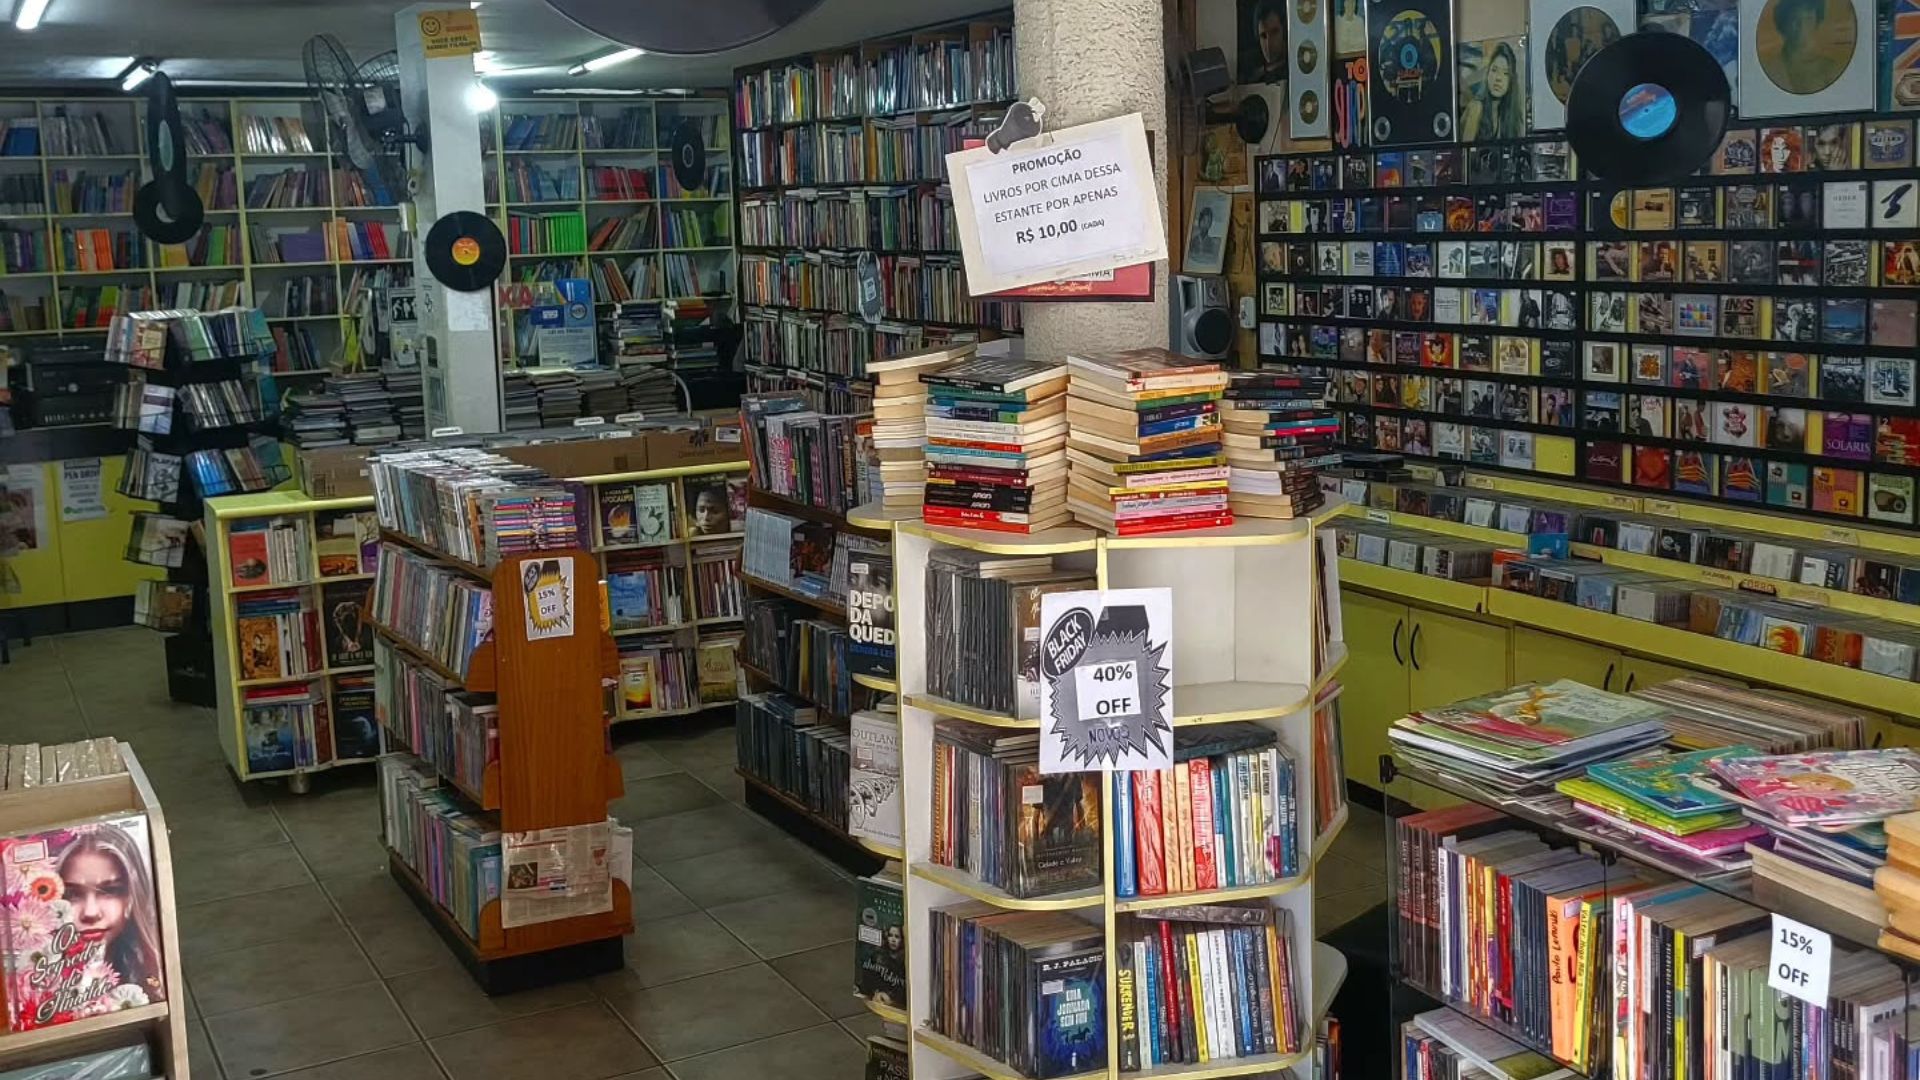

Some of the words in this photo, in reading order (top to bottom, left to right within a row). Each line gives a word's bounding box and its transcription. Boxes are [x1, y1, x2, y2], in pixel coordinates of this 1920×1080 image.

[1012, 148, 1082, 174] PROMOÇÃO
[983, 186, 1023, 204] LIVROS
[1025, 180, 1049, 195] POR
[1050, 171, 1083, 189] CIMA
[1084, 162, 1122, 181] DESSA
[994, 203, 1044, 224] ESTANTE
[1046, 197, 1070, 212] POR
[1072, 186, 1119, 207] APENAS
[1016, 228, 1035, 245] R$
[1039, 218, 1078, 242] 10,00
[1081, 218, 1105, 231] (CADA)
[1725, 298, 1754, 312] INXS
[1826, 439, 1871, 452] SOLARIS
[538, 588, 556, 599] 15%
[540, 604, 557, 615] OFF
[849, 608, 873, 626] DA
[1047, 613, 1083, 659] BLACK
[1053, 632, 1087, 675] FRIDAY
[1093, 664, 1133, 683] 40%
[1096, 697, 1132, 715] OFF
[1088, 725, 1130, 744] NOVOS
[1780, 928, 1813, 955] 15%
[1550, 950, 1563, 984] Paulo
[1778, 963, 1809, 987] OFF
[1118, 969, 1135, 1031] SURRENDER
